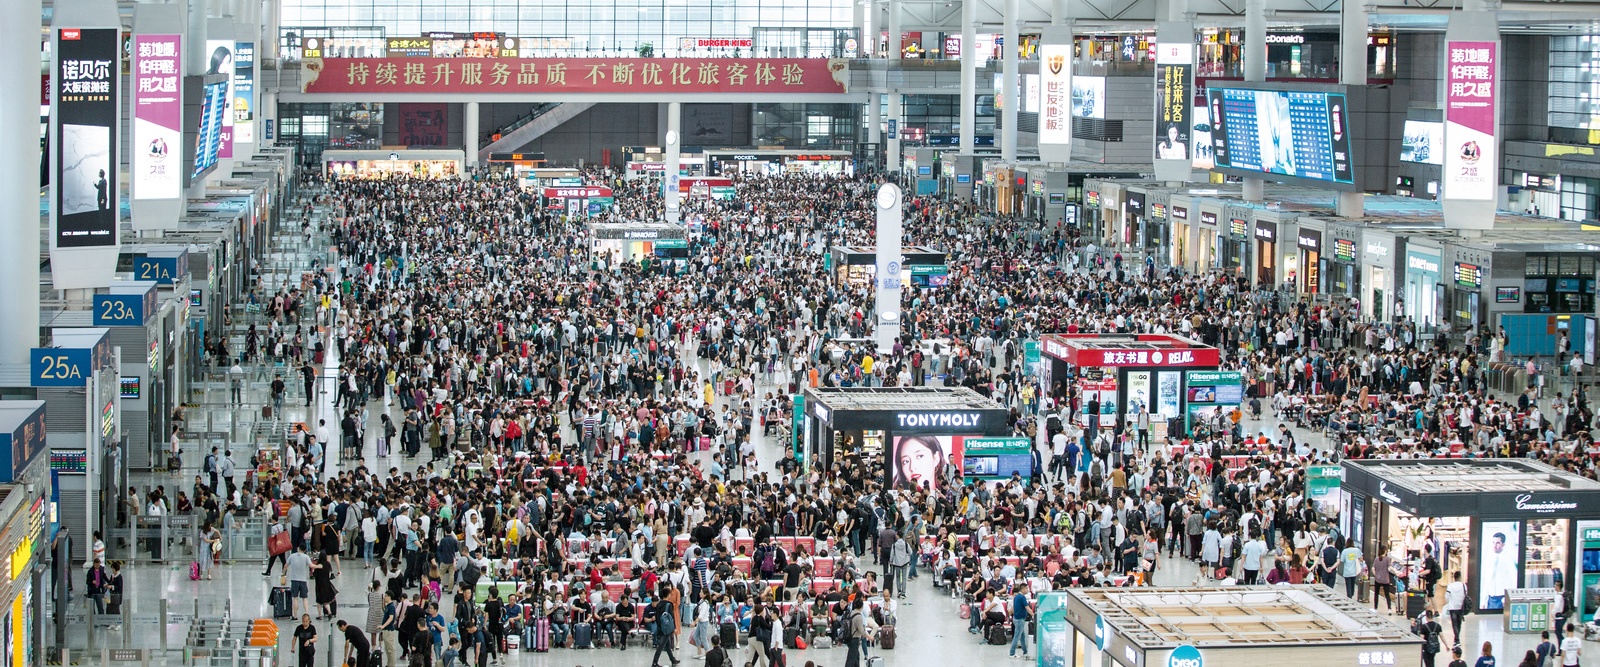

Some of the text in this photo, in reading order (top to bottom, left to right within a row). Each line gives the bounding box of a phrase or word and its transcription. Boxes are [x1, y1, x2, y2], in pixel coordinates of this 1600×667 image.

[1265, 35, 1303, 43] cDonald's
[1451, 48, 1493, 63] 装地暖,
[62, 60, 112, 80] 诺贝尔
[346, 62, 805, 86] 持续提升服务品质 不断优化旅客体验
[1451, 66, 1493, 80] 怕甲醛,
[138, 77, 178, 92] 用久盛
[1450, 82, 1492, 98] 用久盛
[1046, 82, 1058, 130] 世友地板
[141, 262, 170, 279] 21A
[101, 300, 134, 320] 23A
[1104, 351, 1148, 364] 旅友书屋
[40, 356, 81, 379] 25A
[898, 414, 980, 426] TONYMOLY
[1515, 494, 1578, 510] Camicissima
